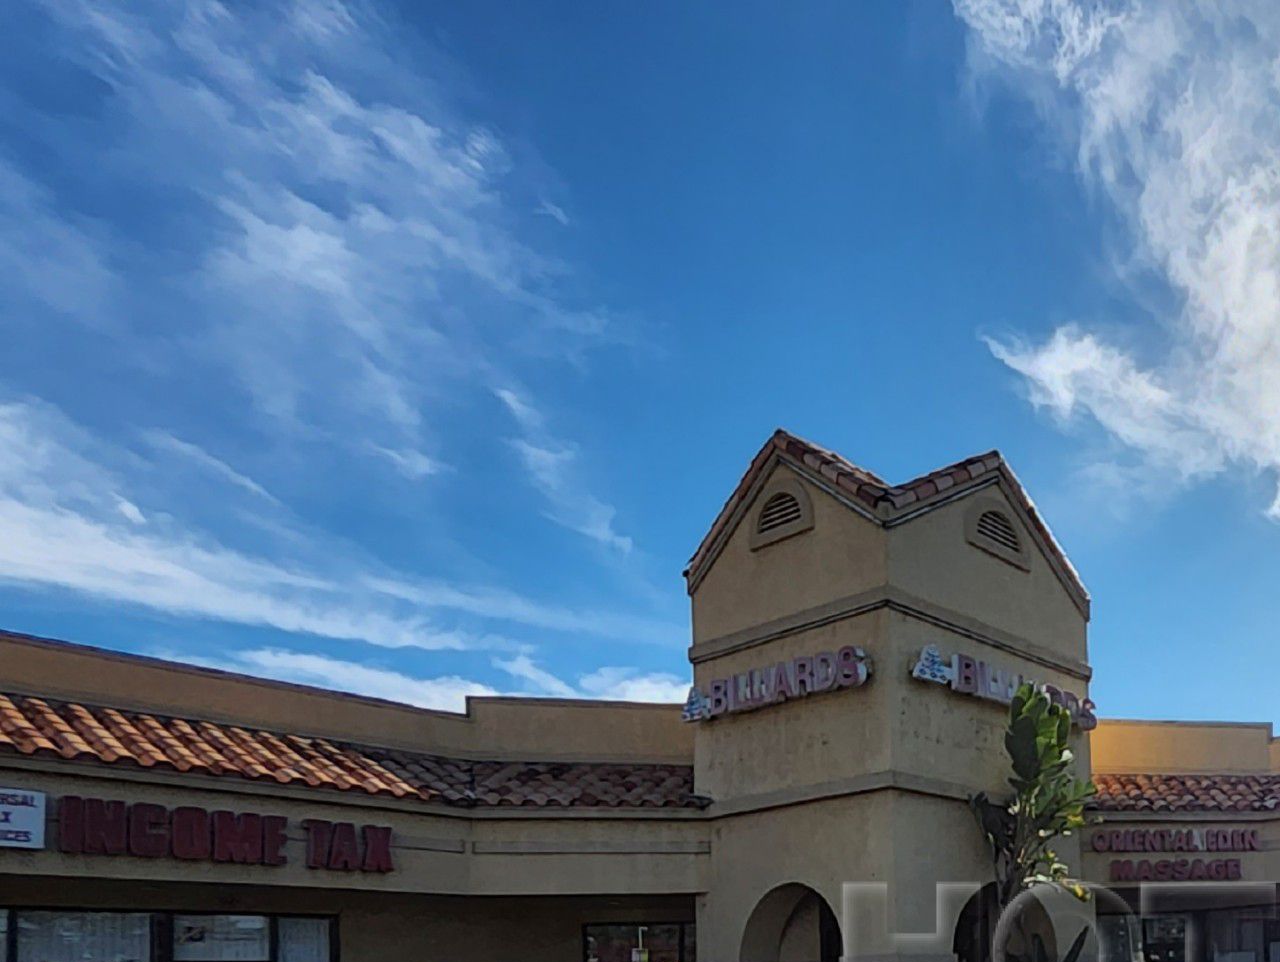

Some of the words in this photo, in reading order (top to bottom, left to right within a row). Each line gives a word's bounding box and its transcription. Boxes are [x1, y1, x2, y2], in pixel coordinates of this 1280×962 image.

[710, 645, 866, 716] BILLIARDS
[58, 796, 288, 866] INCOME
[303, 818, 394, 873] TAX
[1092, 829, 1201, 852] ORIENTAL
[1206, 830, 1258, 852] EDEN
[1110, 859, 1242, 881] MASSAGE
